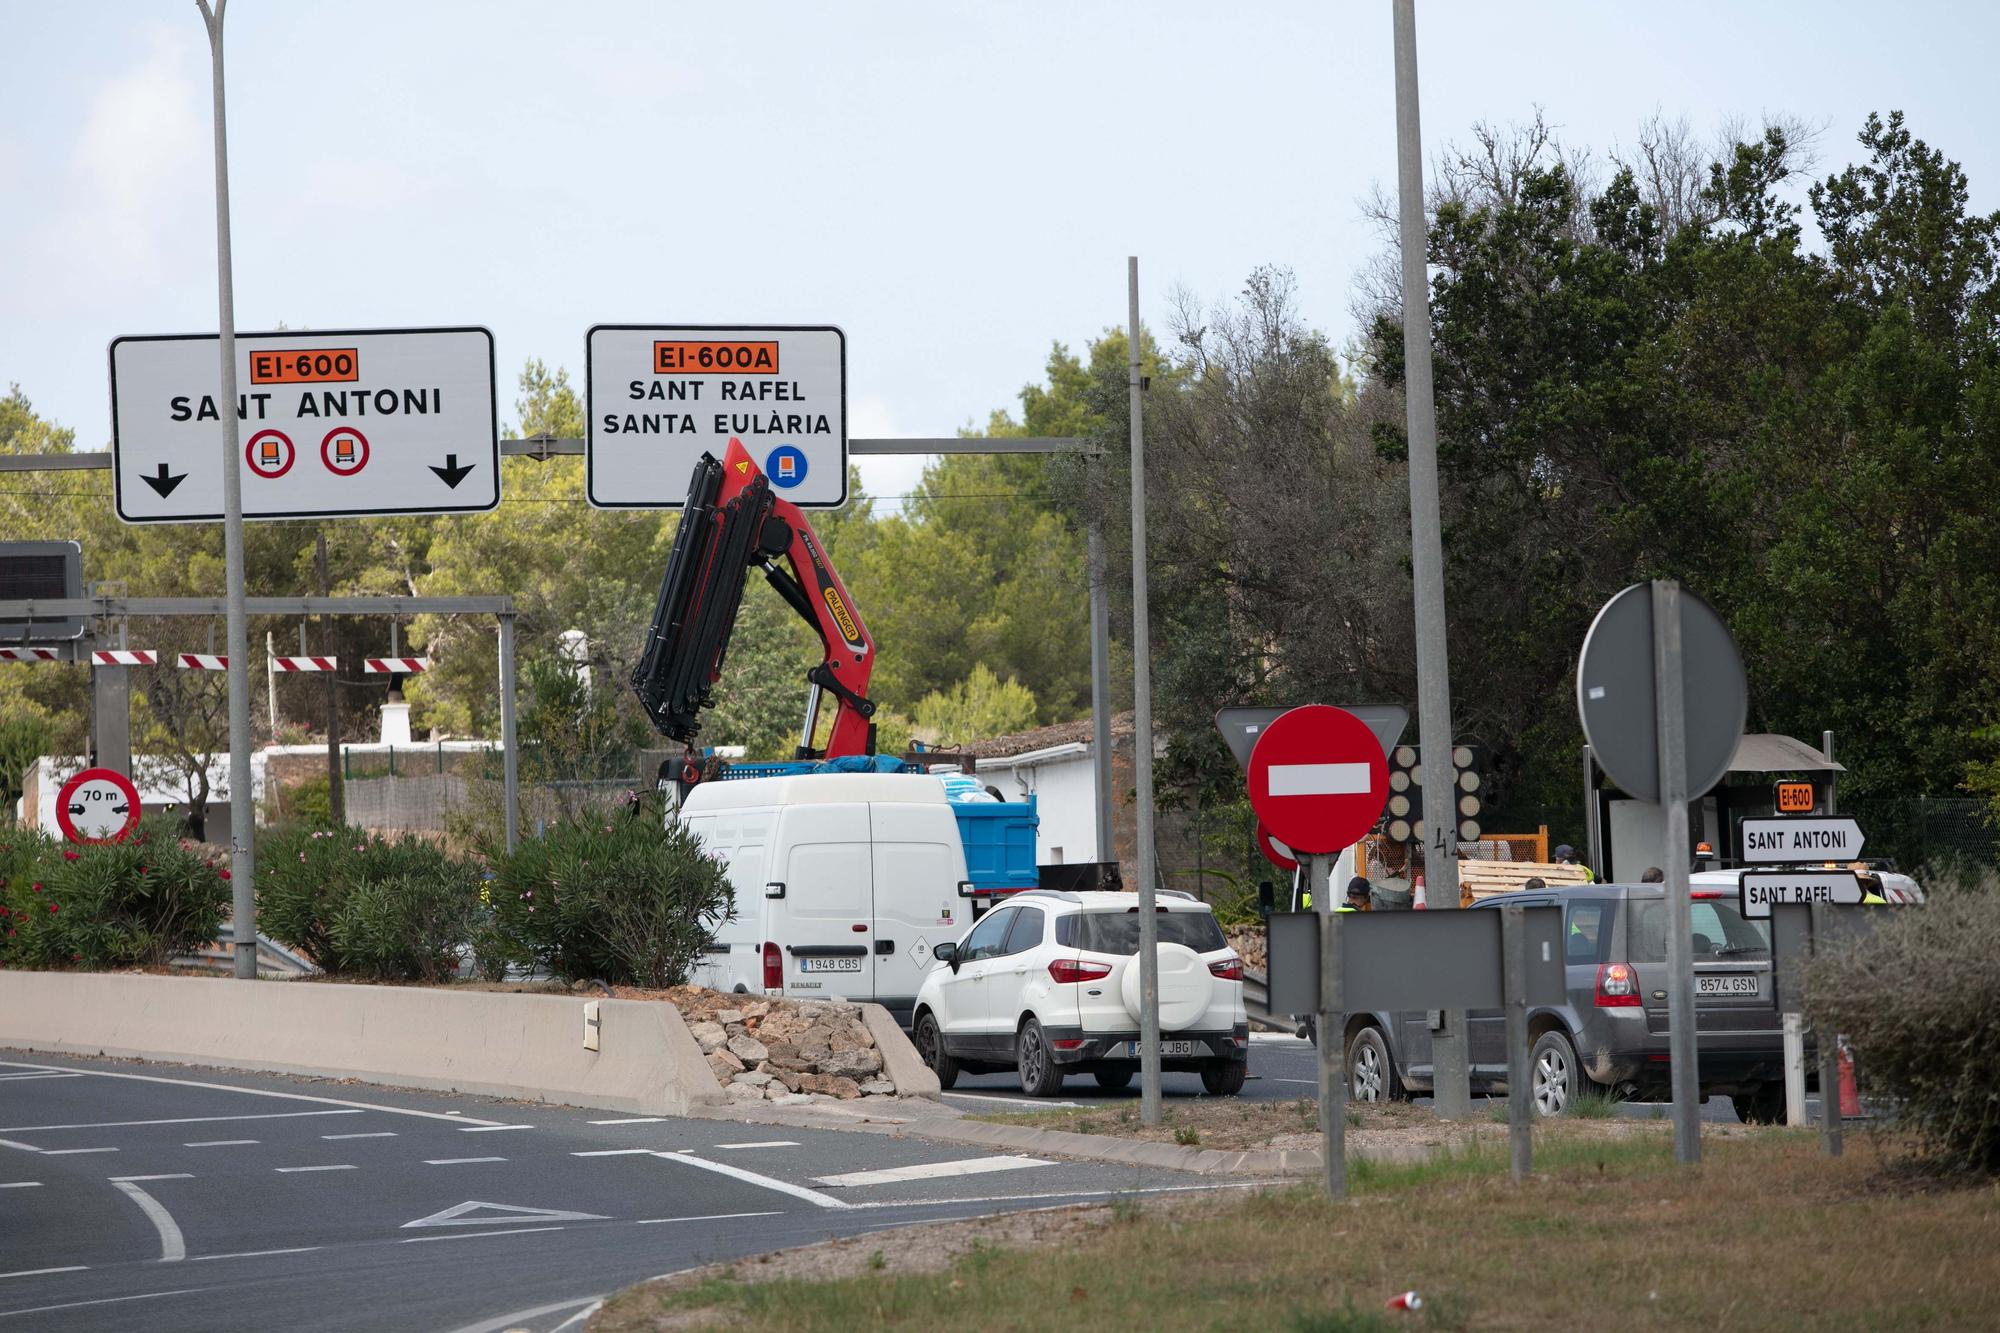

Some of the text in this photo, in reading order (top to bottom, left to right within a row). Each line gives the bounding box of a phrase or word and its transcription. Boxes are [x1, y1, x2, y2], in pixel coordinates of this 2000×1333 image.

[256, 355, 353, 378] EI-600
[660, 347, 773, 368] EI-600A
[629, 380, 806, 401] SANT RAFEL
[296, 388, 441, 418] ANTONI
[603, 410, 832, 434] SANTA EULÀRIA
[827, 590, 857, 638] PALFINGER
[83, 790, 117, 801] 70 m
[1782, 789, 1810, 806] EI-600
[1748, 831, 1846, 849] SANT ANTONI
[1750, 886, 1834, 904] SANT RAFEL
[810, 959, 858, 969] 1948 CBS
[1700, 978, 1756, 991] 8574 GSN
[1168, 1042, 1189, 1053] JBG
